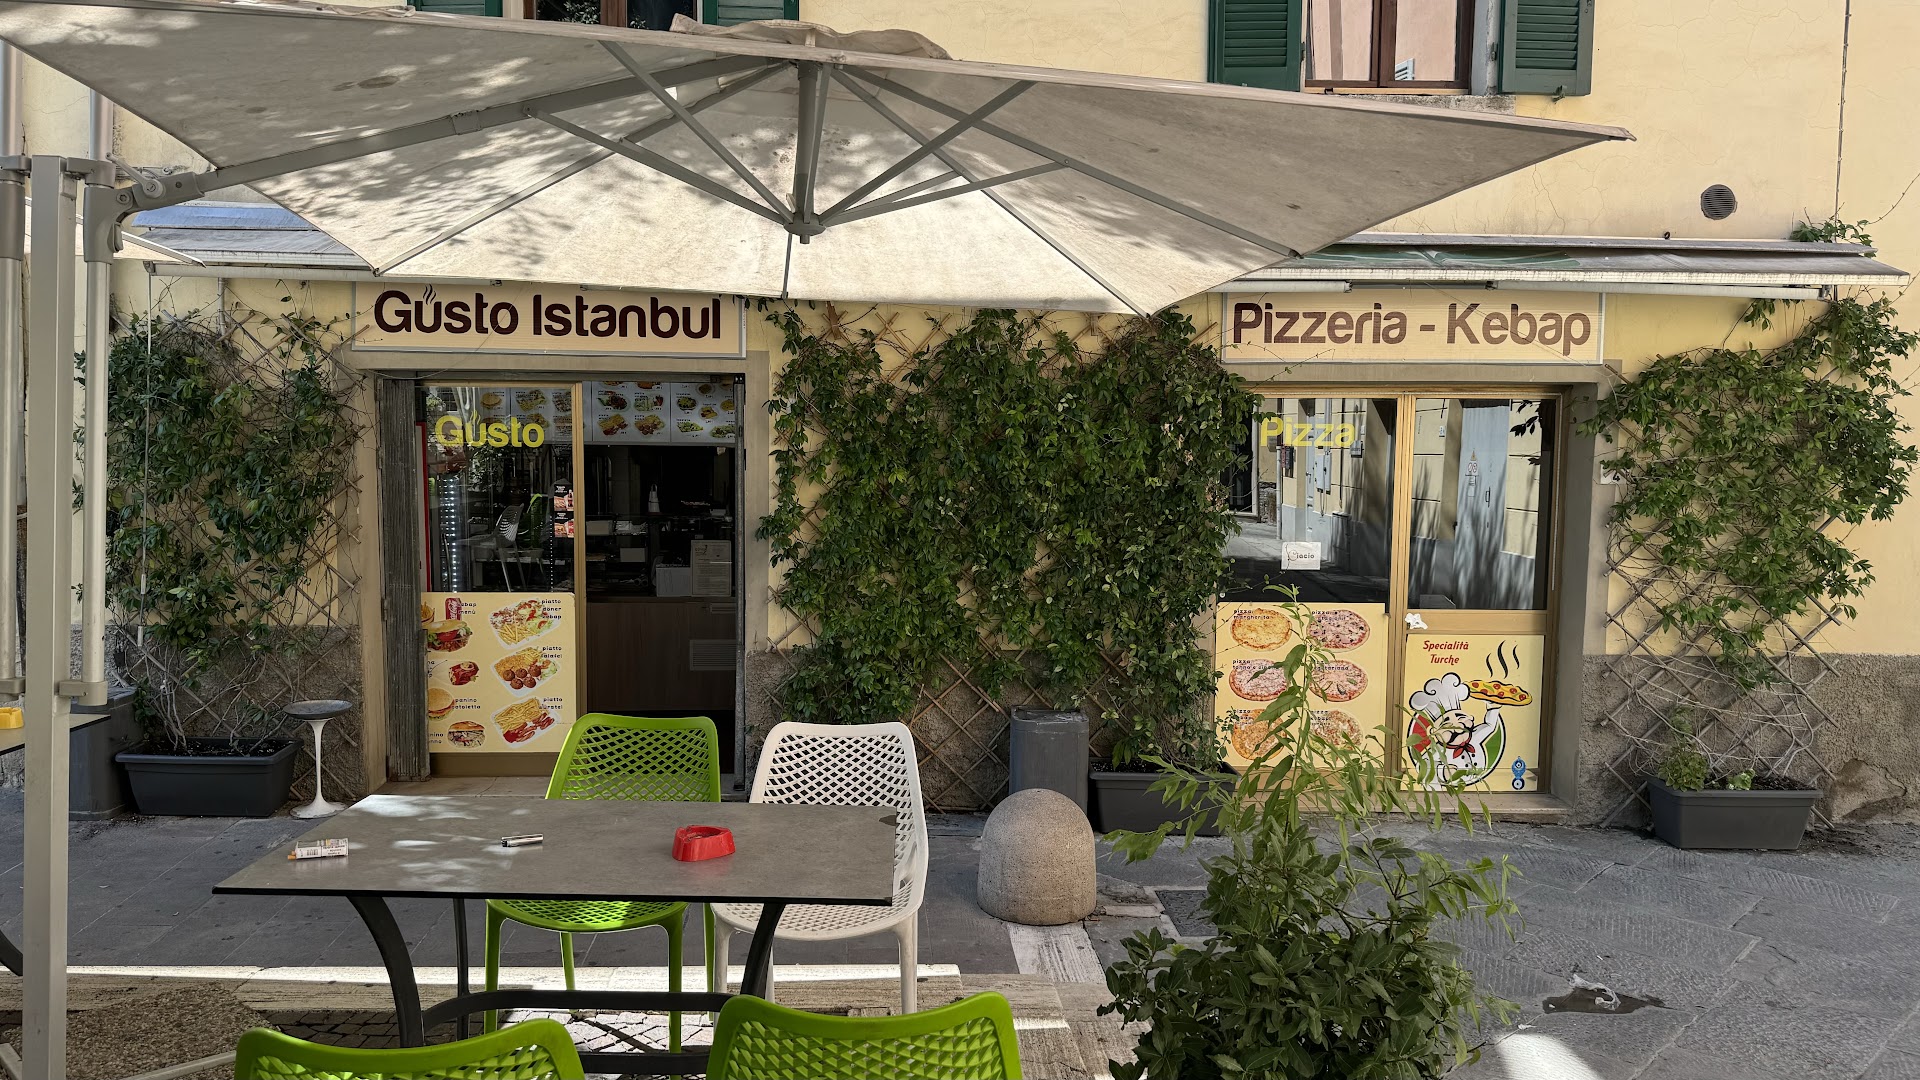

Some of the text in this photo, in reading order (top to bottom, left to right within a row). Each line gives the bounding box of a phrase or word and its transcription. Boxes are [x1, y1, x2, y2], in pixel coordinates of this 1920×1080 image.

[374, 285, 721, 339] Gusto Istanbul
[1234, 302, 1407, 345] Pizzeria
[1447, 303, 1591, 357] Kebap
[435, 414, 545, 449] Gusto
[1260, 417, 1356, 448] Pizza
[1422, 640, 1470, 652] Specialità
[1430, 654, 1460, 665] Turche
